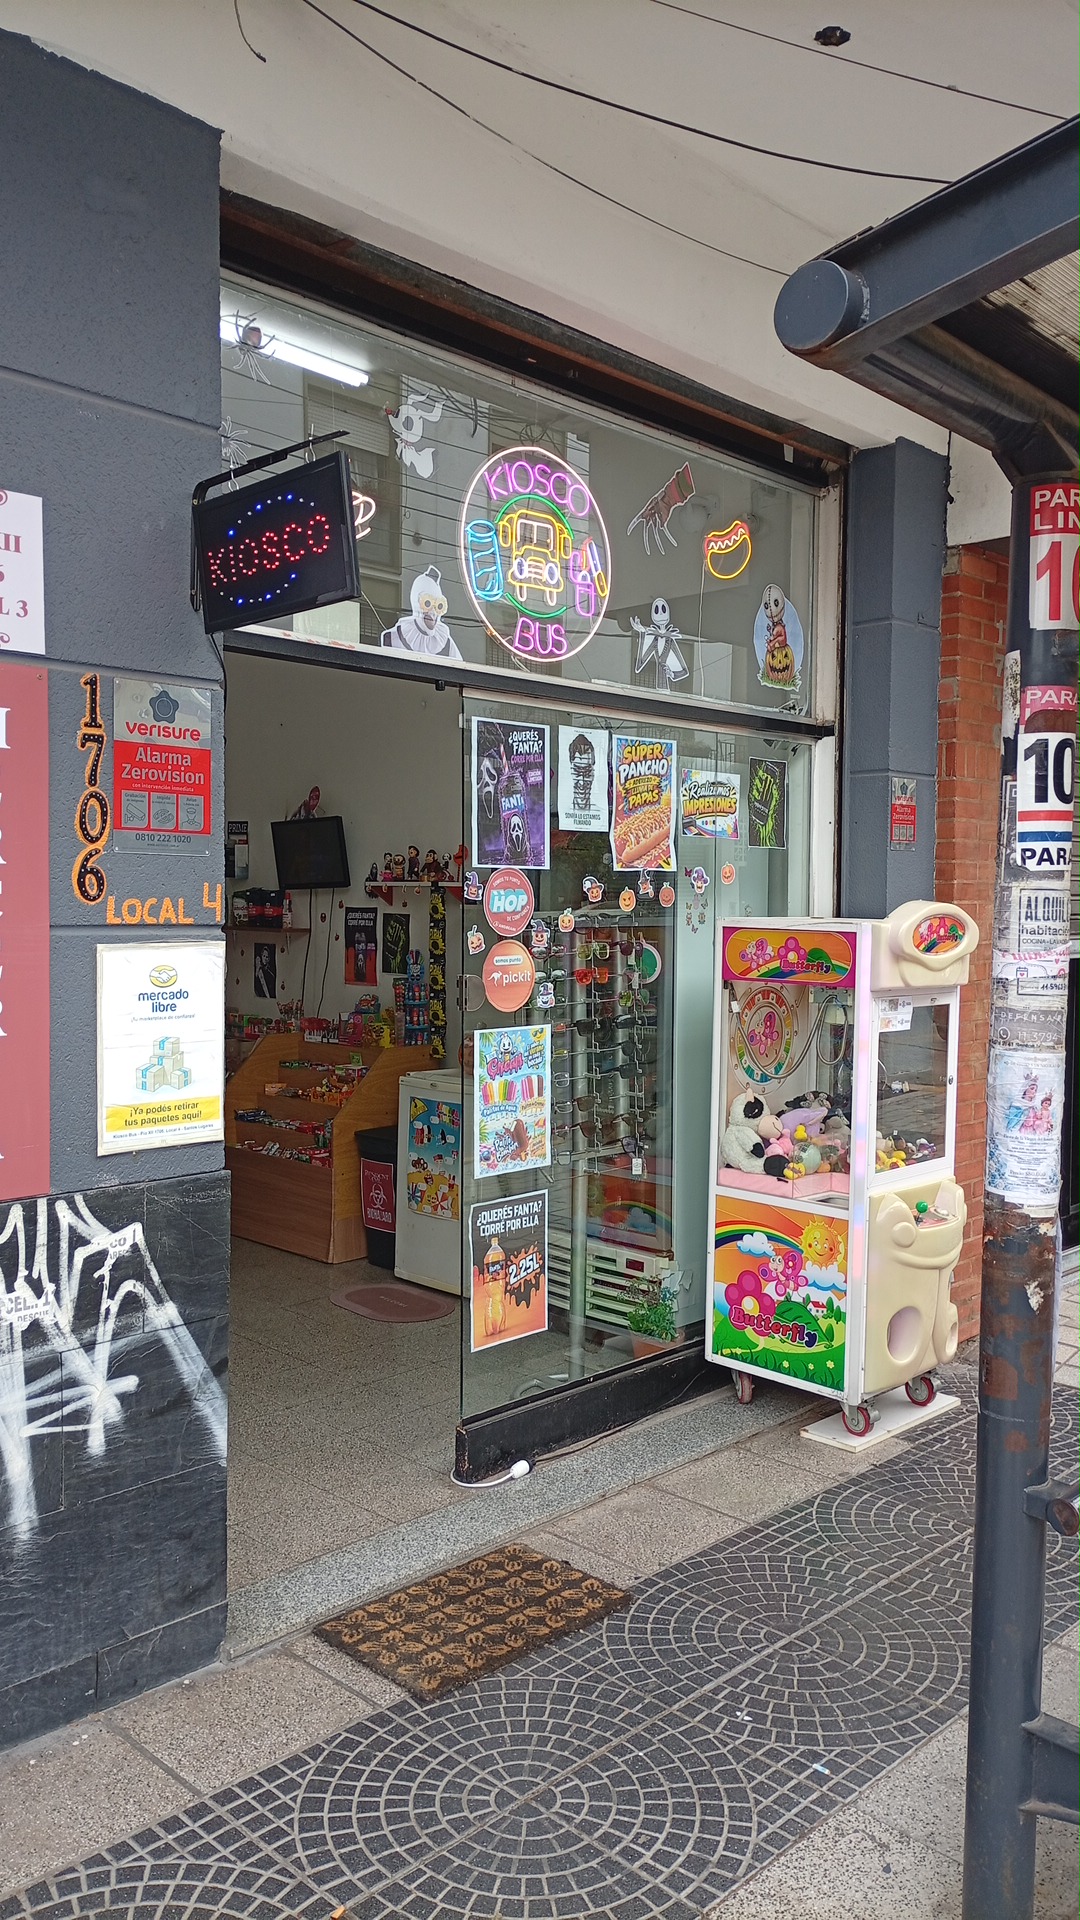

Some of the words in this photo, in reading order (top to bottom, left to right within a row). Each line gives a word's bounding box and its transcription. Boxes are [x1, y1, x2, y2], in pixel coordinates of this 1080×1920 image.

[484, 461, 590, 516] KIOSCO
[207, 514, 330, 587] KIOSCO
[16, 600, 29, 618] 3
[513, 617, 568, 655] BUS
[126, 721, 200, 741] verisure
[508, 730, 539, 745] ¿QUERÉS
[136, 746, 191, 766] Alarma
[513, 740, 543, 755] FANTA?
[623, 740, 663, 763] SÚPER
[121, 763, 204, 784] Zerovision
[619, 758, 668, 784] PANCHO
[1024, 737, 1074, 804] 10
[628, 789, 659, 810] PAPAS
[135, 833, 155, 841] 0810
[155, 834, 171, 842] 222
[174, 836, 191, 844] 1020
[106, 896, 194, 925] LOCAL
[202, 882, 222, 922] 4
[490, 890, 528, 913] HOP
[1025, 896, 1070, 923] ALQUIL
[509, 957, 522, 965] punto
[780, 957, 831, 974] Butterfly
[502, 969, 531, 986] pickit
[138, 988, 189, 1002] mercado
[151, 1001, 177, 1013] libre
[129, 1107, 144, 1117] ¡Ya
[145, 1103, 172, 1115] podés
[173, 1101, 199, 1112] retirar
[124, 1117, 139, 1127] tus
[141, 1113, 179, 1126] paquetes
[477, 1204, 512, 1227] ¿QUERÉS
[514, 1200, 542, 1217] FANTA?
[479, 1218, 505, 1237] CORRÉ
[506, 1219, 521, 1233] POR
[522, 1214, 539, 1229] ELLA
[508, 1252, 540, 1286] 2.25L
[731, 1305, 818, 1348] Butterfly
